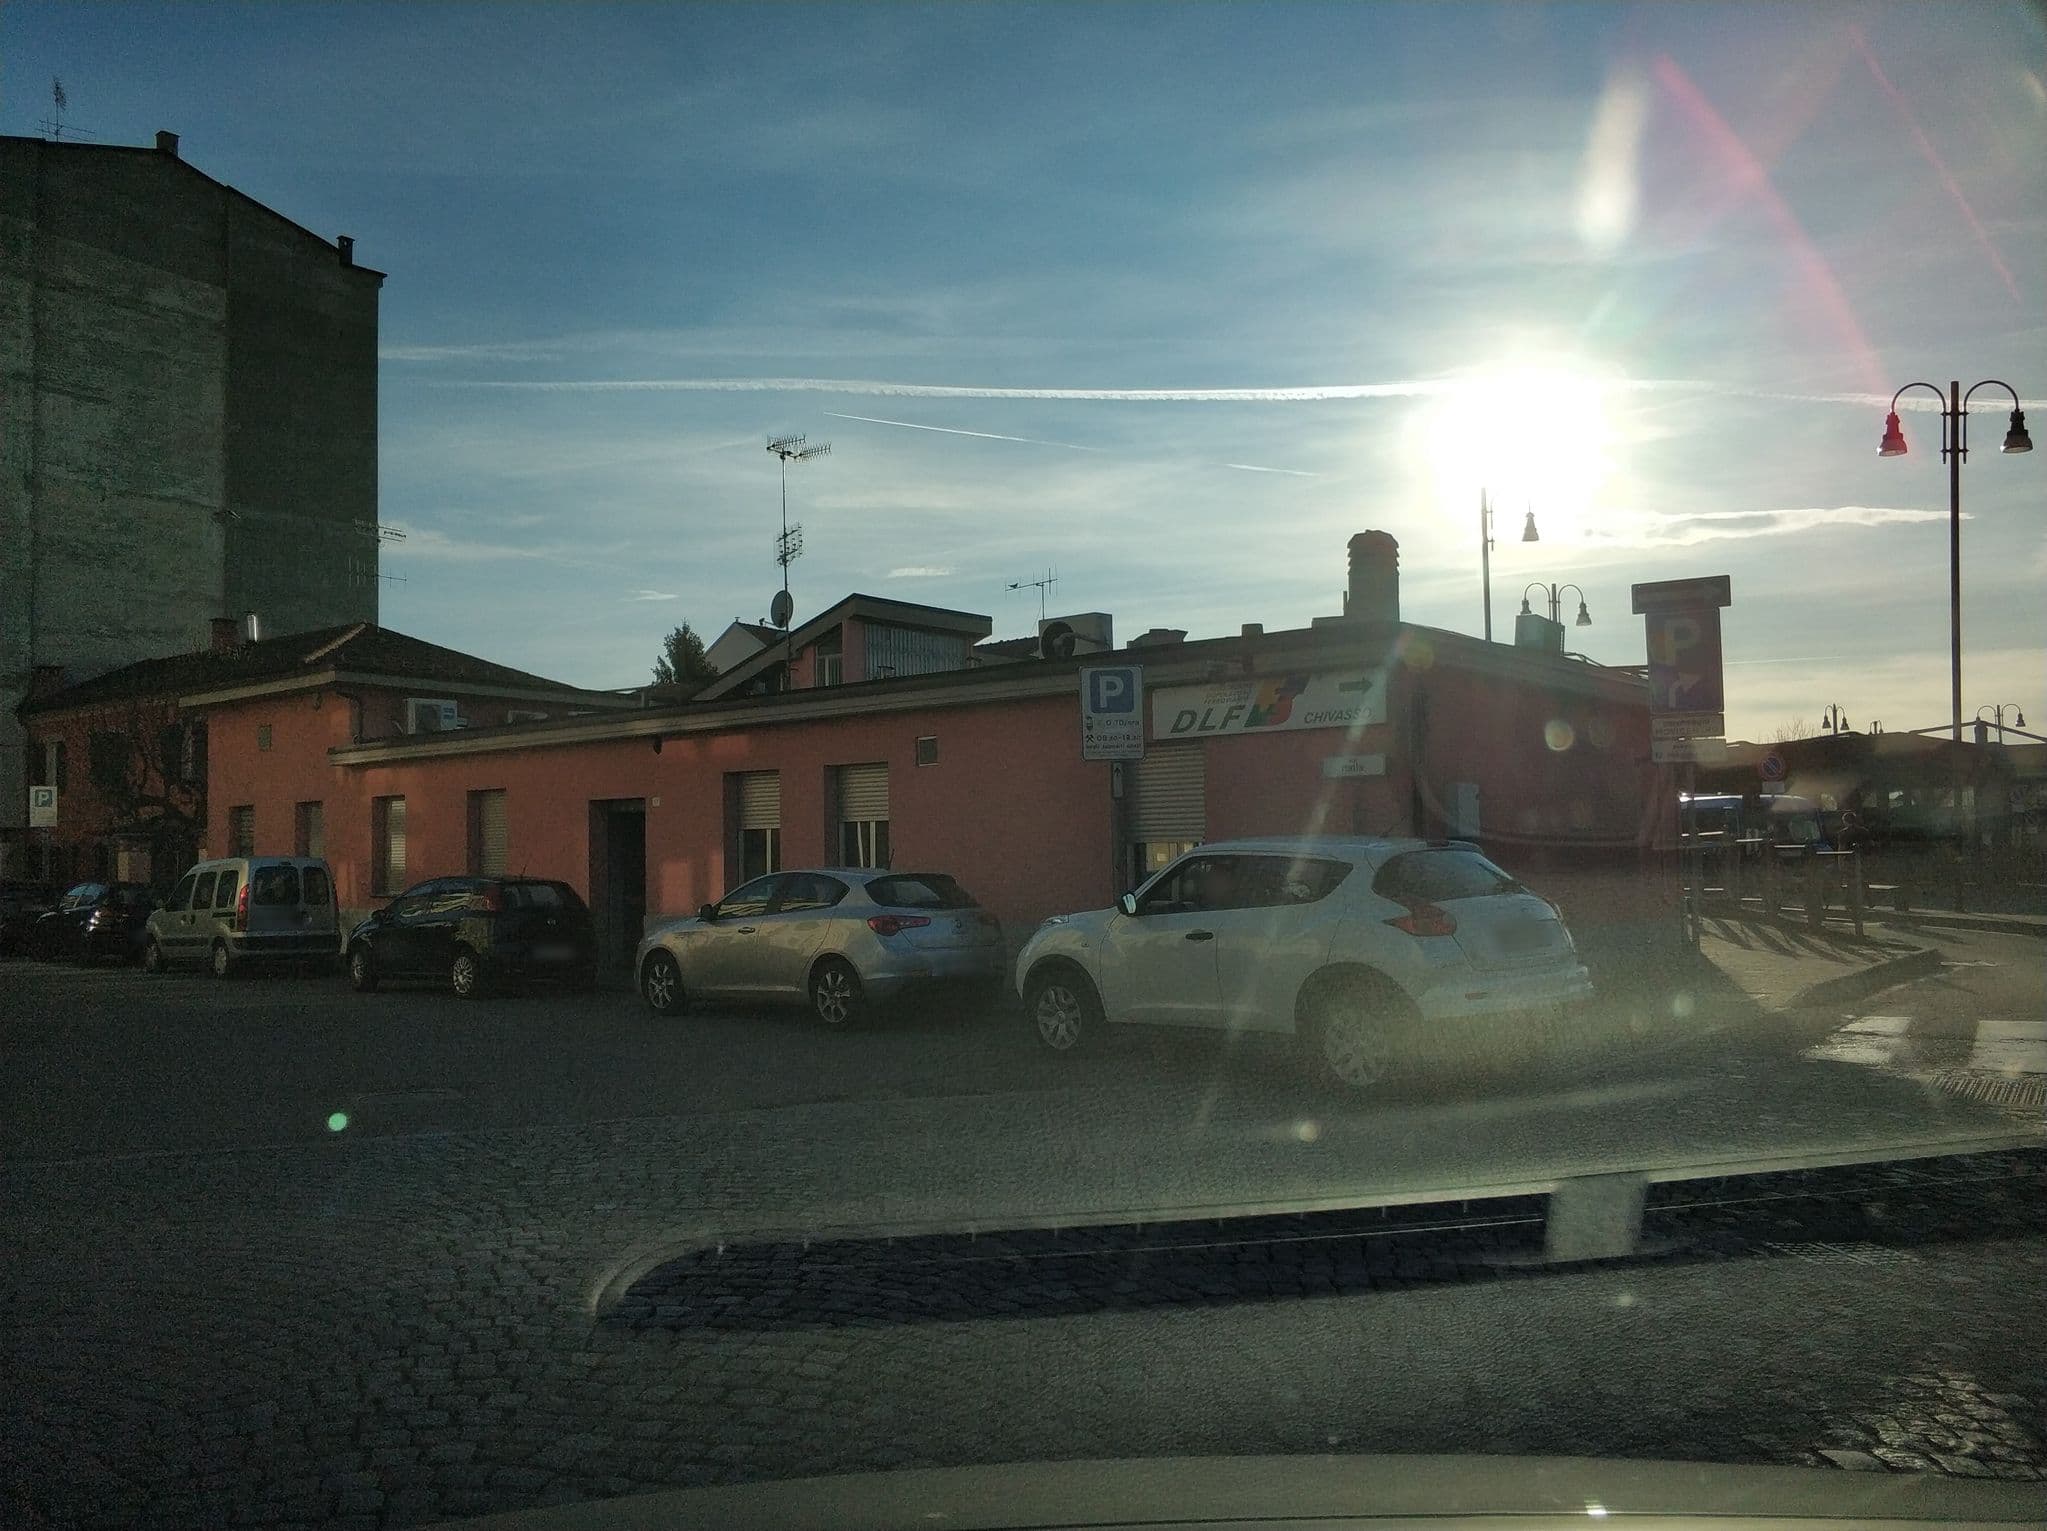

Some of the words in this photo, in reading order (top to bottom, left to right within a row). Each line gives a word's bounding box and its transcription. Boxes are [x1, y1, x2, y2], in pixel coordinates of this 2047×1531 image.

[1664, 618, 1701, 666] P
[1099, 675, 1124, 708] P
[1170, 704, 1246, 733] DLF
[38, 791, 49, 806] P
